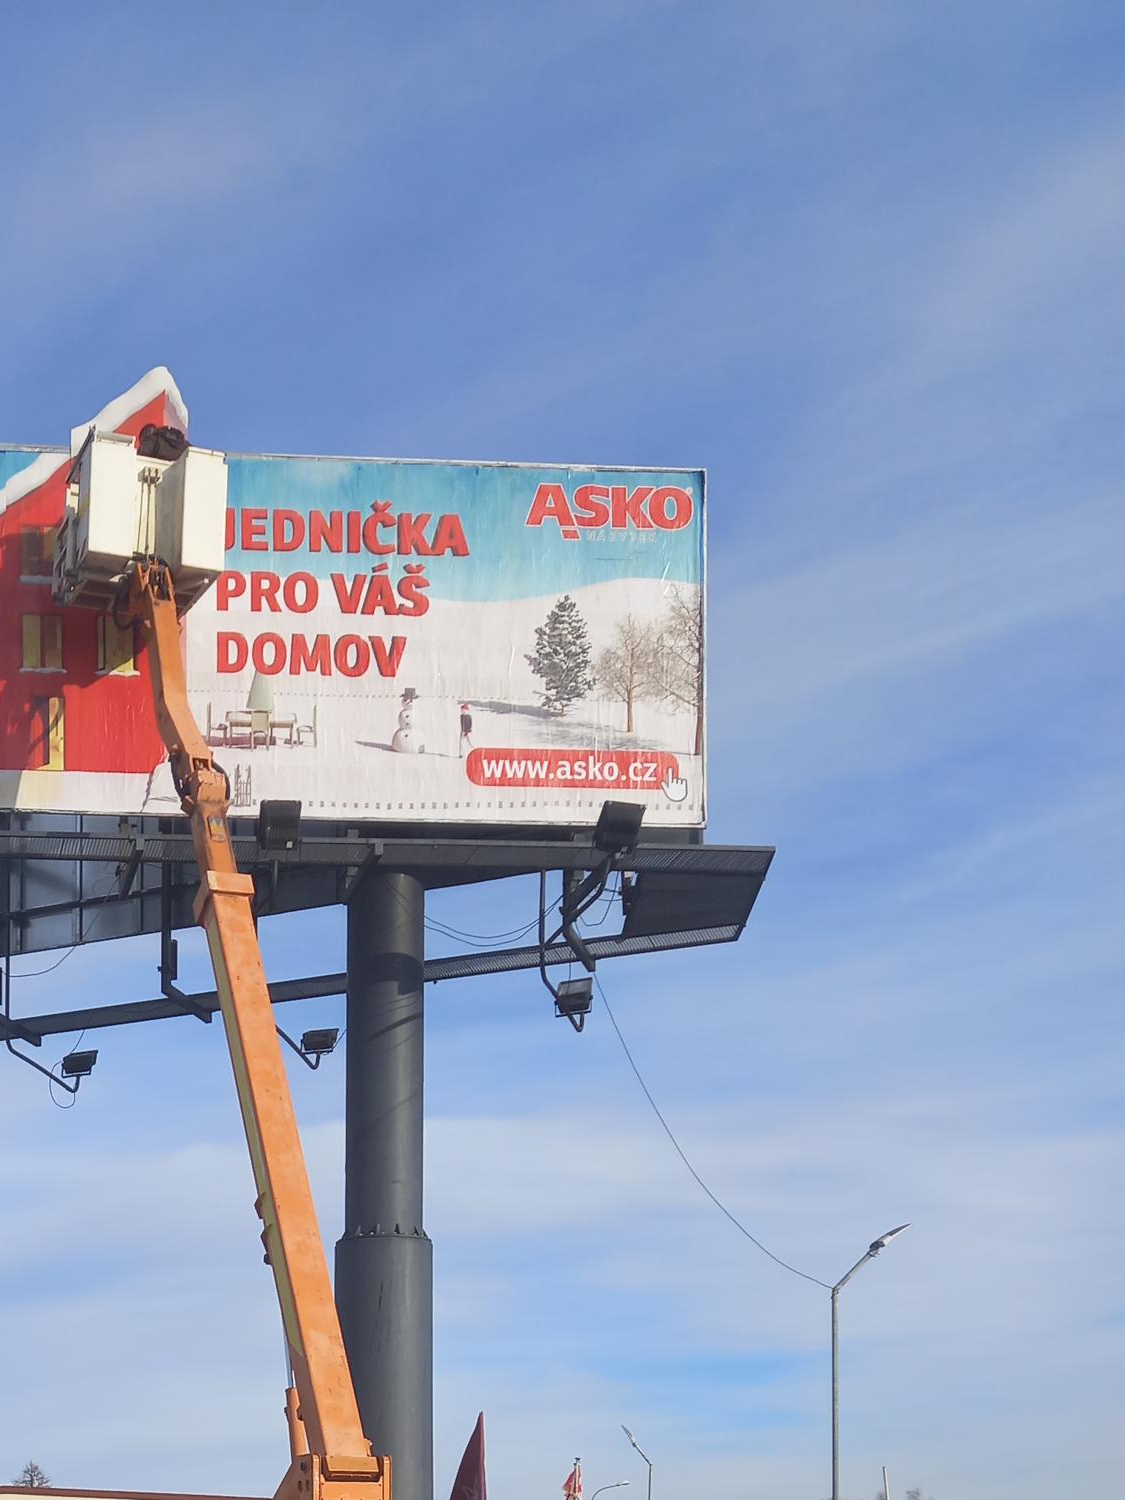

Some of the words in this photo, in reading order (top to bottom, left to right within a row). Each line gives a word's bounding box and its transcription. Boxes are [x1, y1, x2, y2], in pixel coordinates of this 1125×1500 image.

[225, 501, 470, 557] JEDNIČKA
[526, 483, 693, 540] ASKO
[216, 570, 319, 614] PRO
[330, 562, 431, 617] VÁŠ
[216, 631, 407, 678] DOMOV
[482, 756, 658, 782] www.asko.cz
